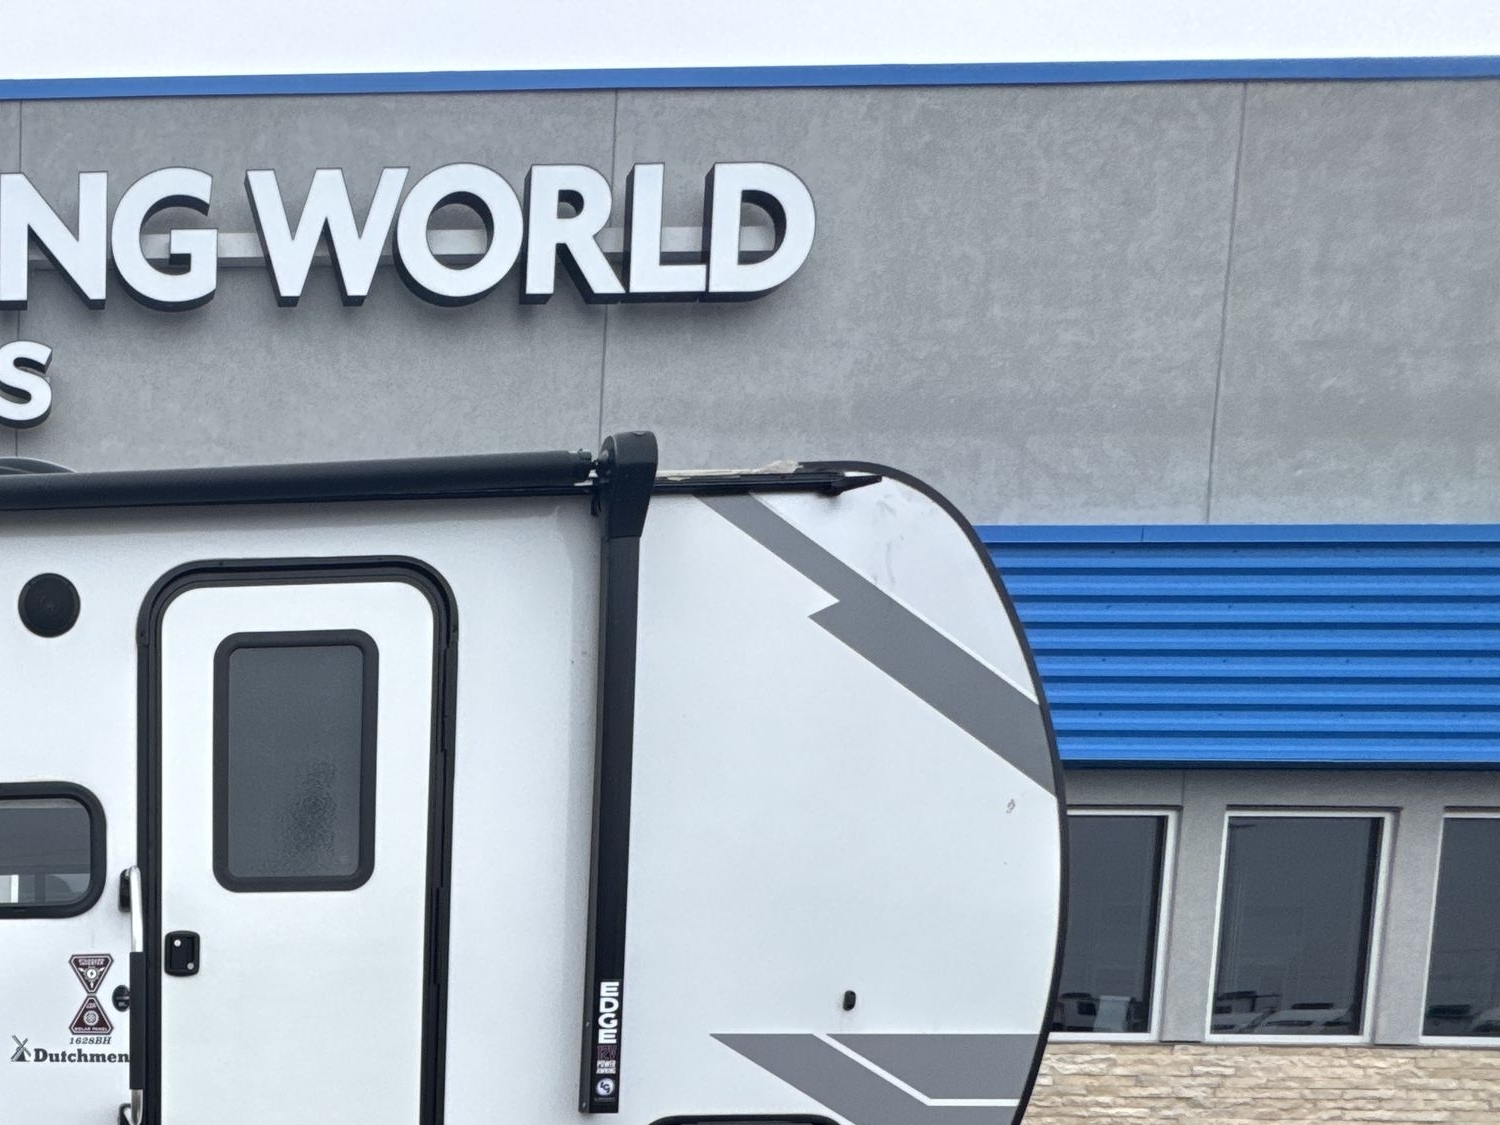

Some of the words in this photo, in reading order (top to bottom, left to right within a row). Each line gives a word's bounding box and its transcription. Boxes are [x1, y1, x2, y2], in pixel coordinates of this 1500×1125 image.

[245, 161, 816, 303] WORLD
[598, 981, 619, 1044] EDGE
[33, 1048, 130, 1063] Dutchmen
